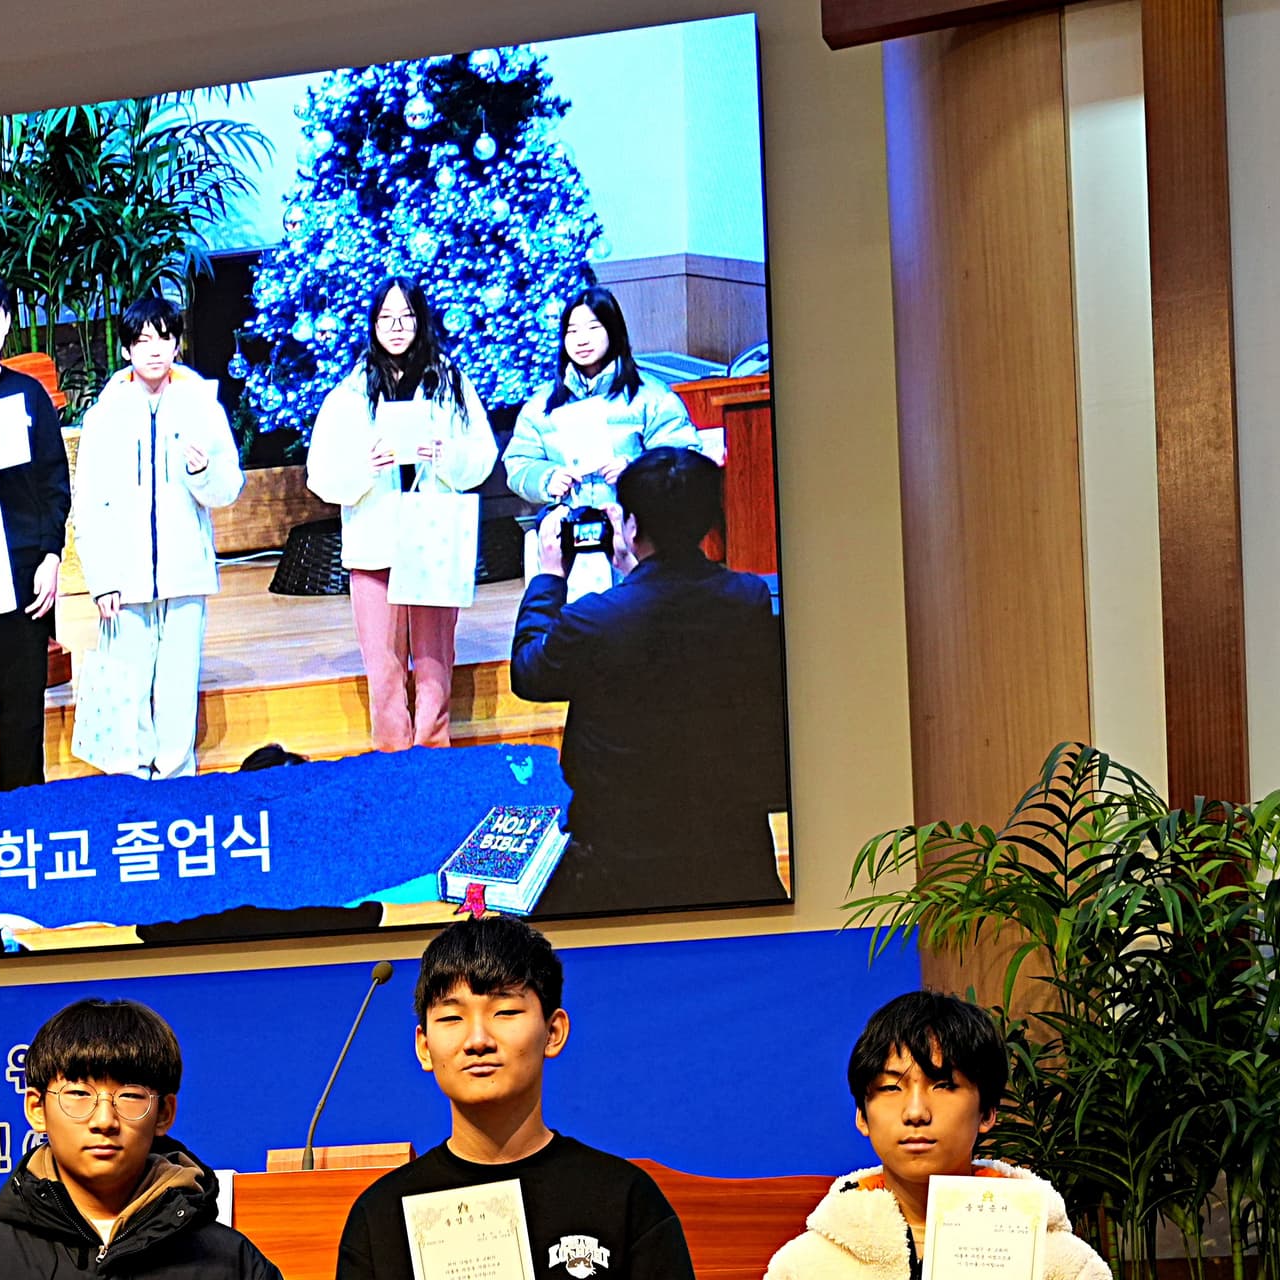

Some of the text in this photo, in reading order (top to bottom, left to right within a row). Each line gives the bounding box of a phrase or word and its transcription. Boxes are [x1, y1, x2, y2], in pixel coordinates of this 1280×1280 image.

[491, 814, 542, 836] HOLY
[111, 810, 271, 883] 졸업식
[479, 833, 534, 854] BIBLE
